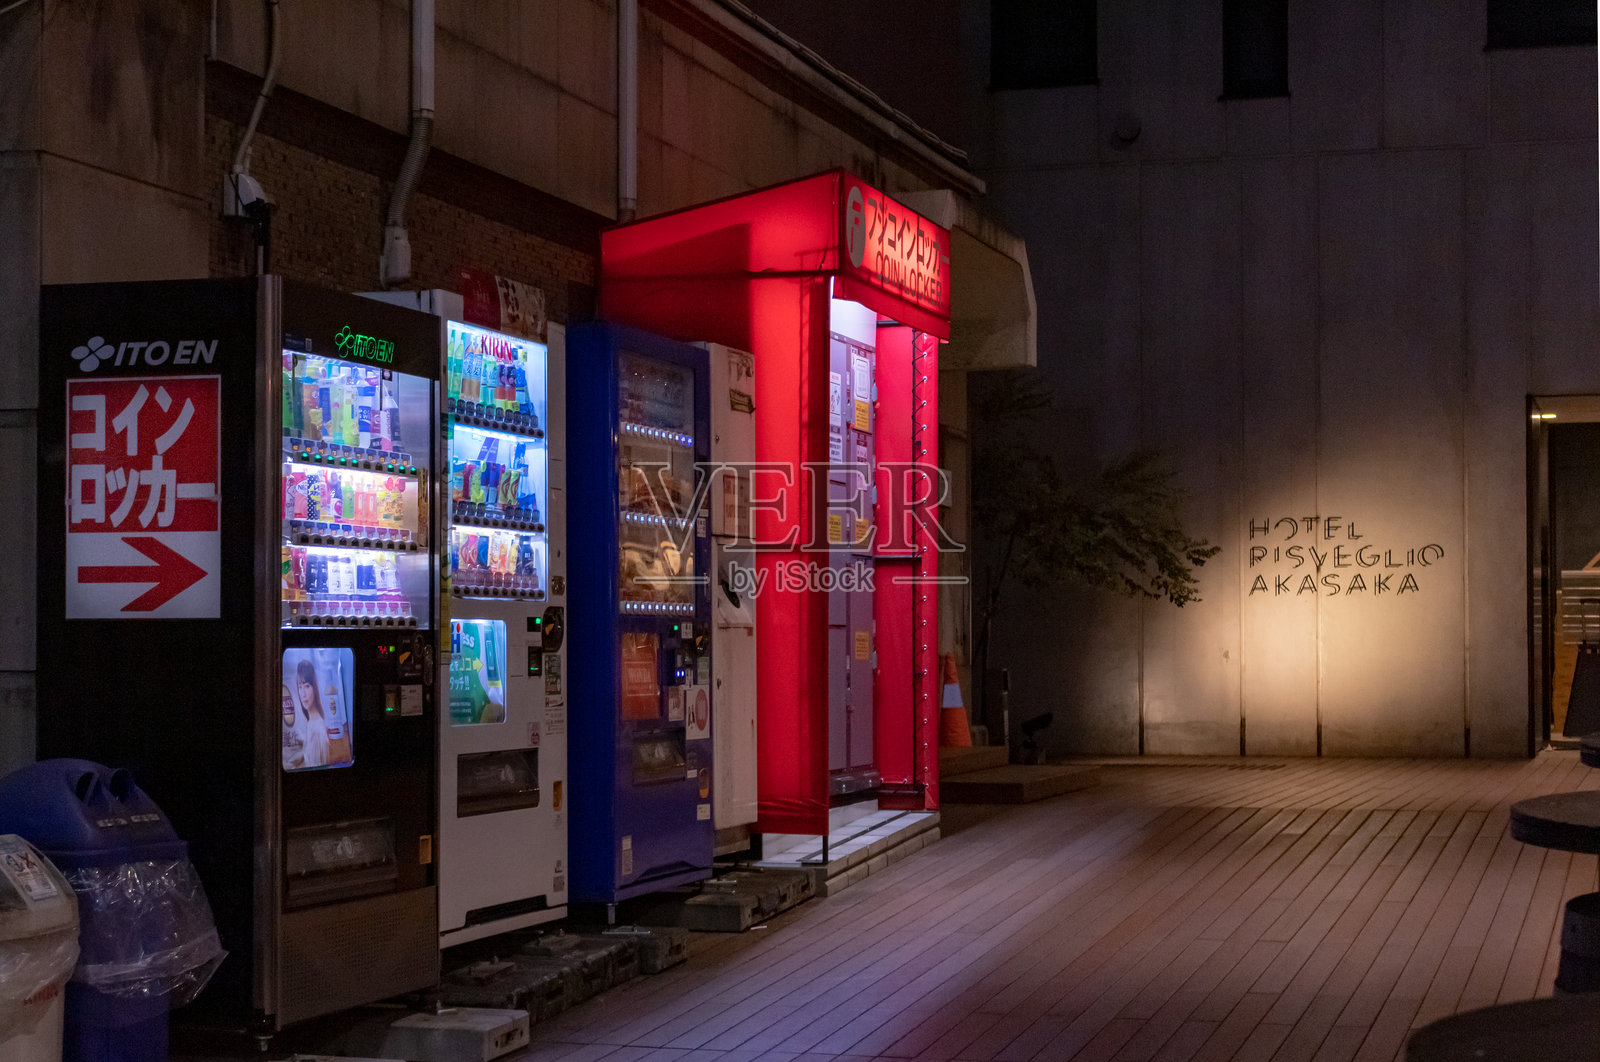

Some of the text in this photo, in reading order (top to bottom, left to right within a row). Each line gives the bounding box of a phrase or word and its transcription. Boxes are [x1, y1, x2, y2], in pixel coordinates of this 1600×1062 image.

[481, 334, 513, 361] KIRIN
[71, 383, 195, 456] コイン
[71, 454, 216, 529] ロッカー
[1249, 517, 1364, 541] HOTEL
[1249, 543, 1445, 569] RISVEGLIO
[1248, 573, 1420, 597] AKASAKA
